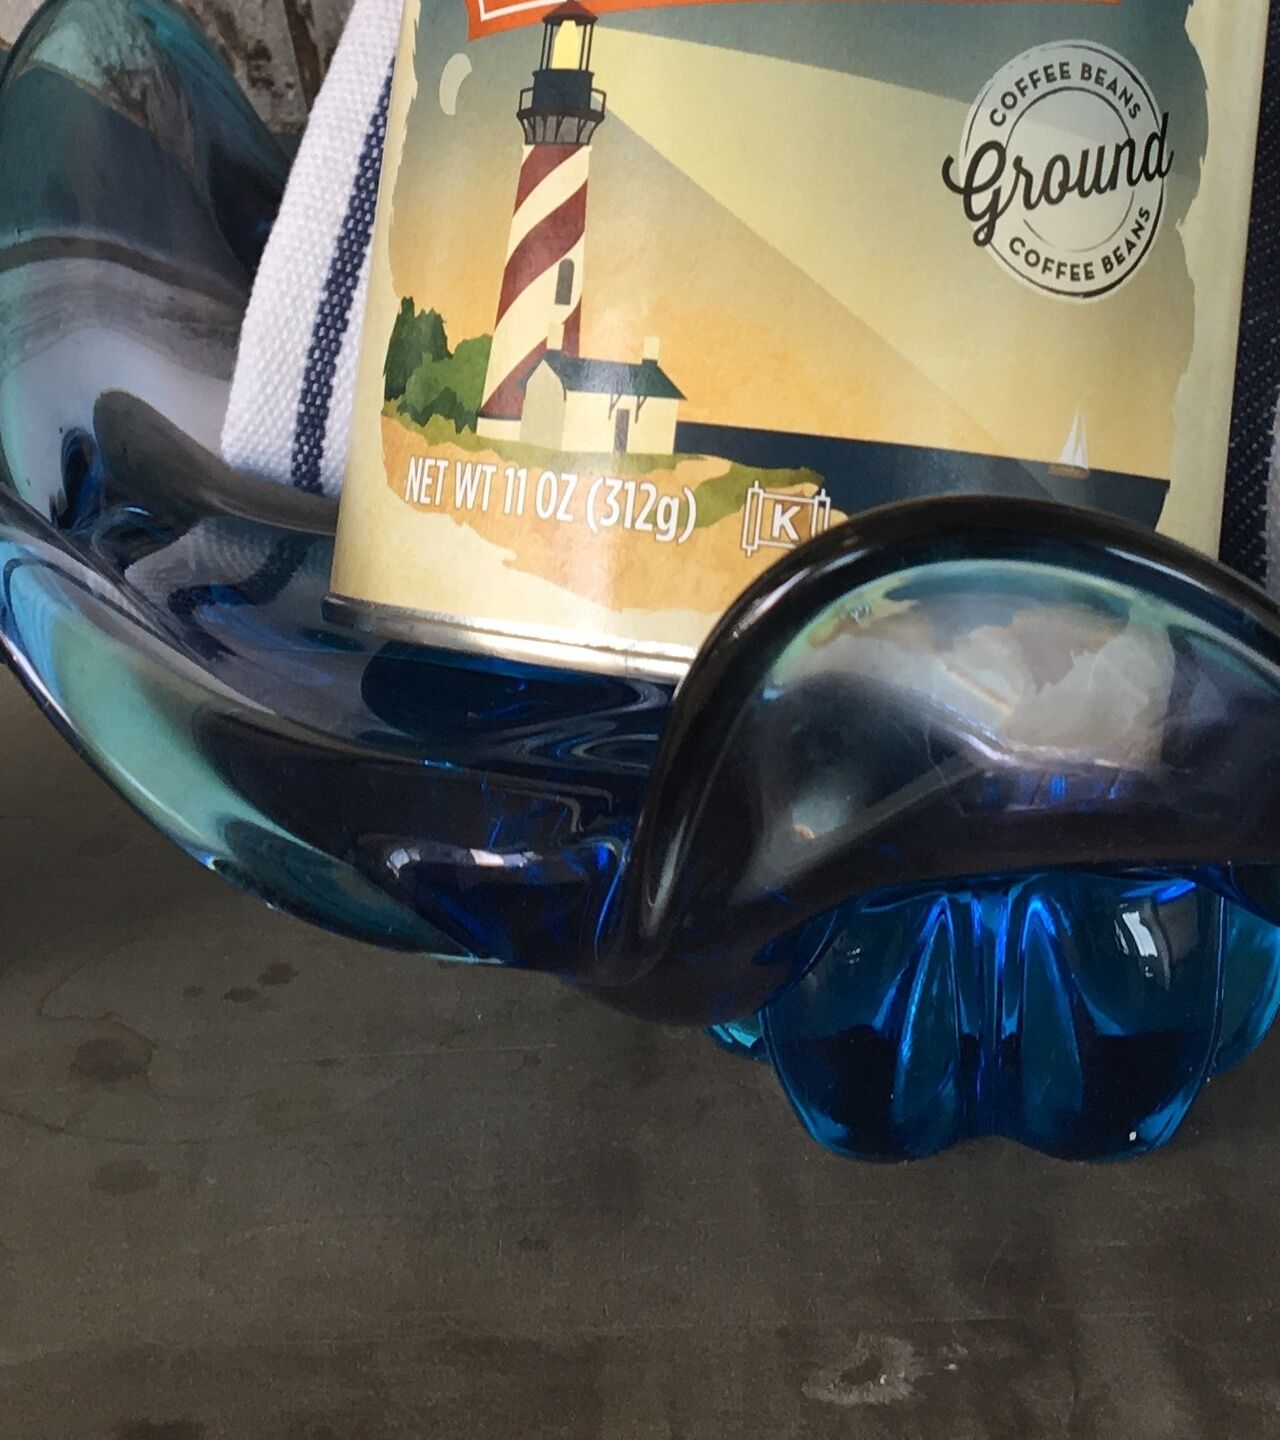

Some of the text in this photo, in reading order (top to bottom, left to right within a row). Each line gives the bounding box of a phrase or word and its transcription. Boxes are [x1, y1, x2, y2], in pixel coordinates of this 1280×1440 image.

[989, 61, 1142, 127] COFFEE BEANS
[941, 111, 1175, 247] Ground
[1009, 206, 1151, 282] COFFEE BEANS
[404, 456, 698, 545] NET WT 11 OZ (312g)
[772, 502, 802, 541] K
